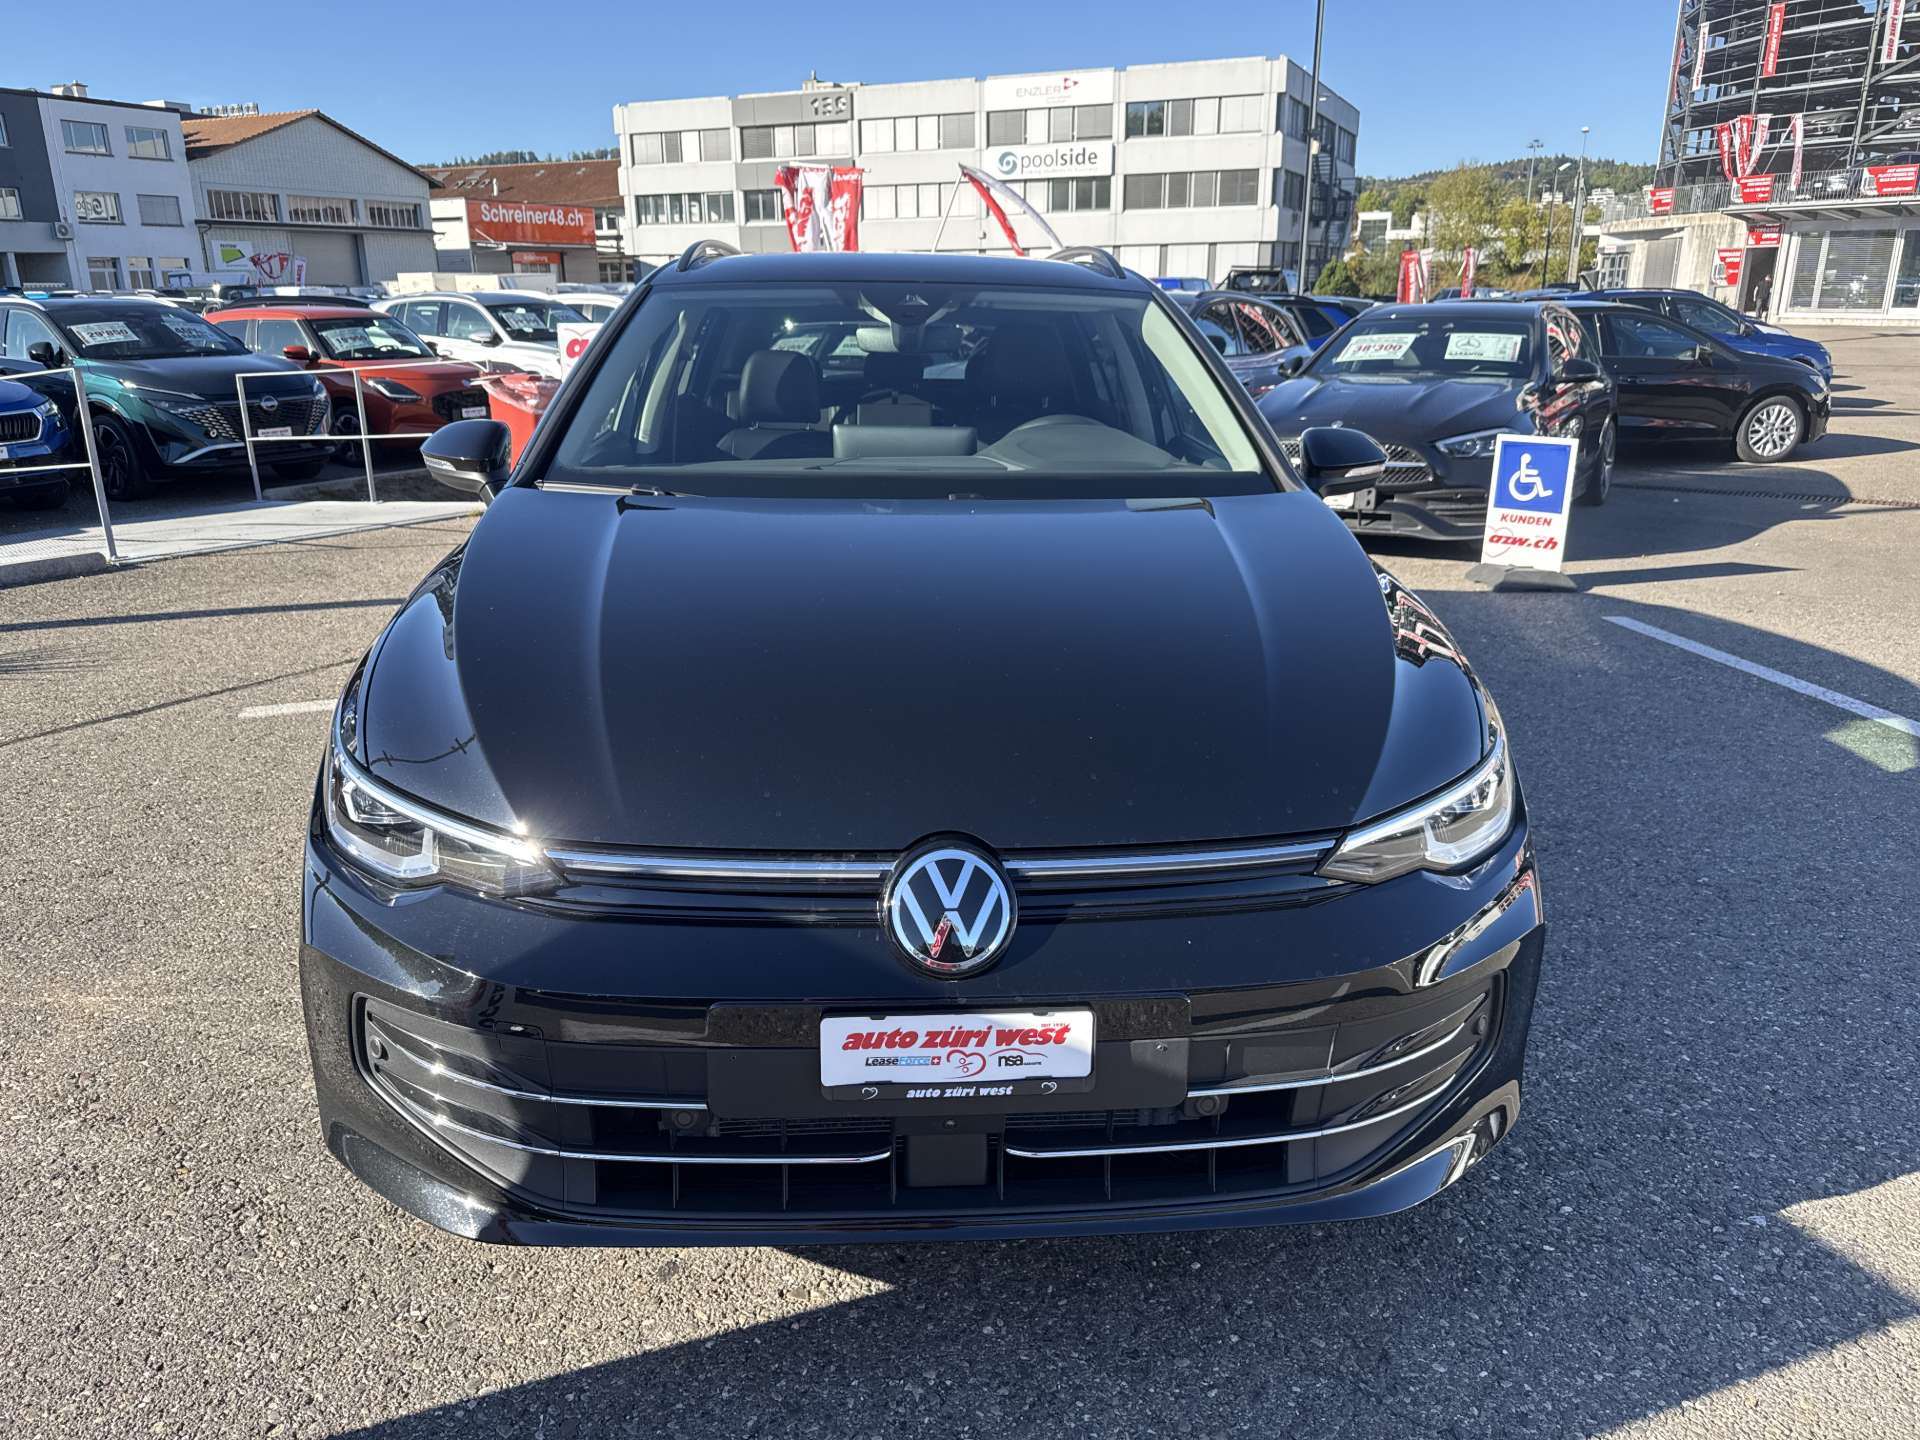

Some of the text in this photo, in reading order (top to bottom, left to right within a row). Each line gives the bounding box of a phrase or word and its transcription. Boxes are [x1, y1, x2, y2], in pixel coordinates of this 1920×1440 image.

[1016, 84, 1062, 98] ENZLER
[1020, 147, 1098, 175] poolside
[480, 203, 584, 227] Schreiner48.ch
[1500, 513, 1553, 527] KUNDEN
[1488, 535, 1559, 551] azw.ch
[841, 1023, 1072, 1051] auto züri west
[997, 1055, 1024, 1067] nsa
[906, 1085, 1014, 1099] auto züri west
